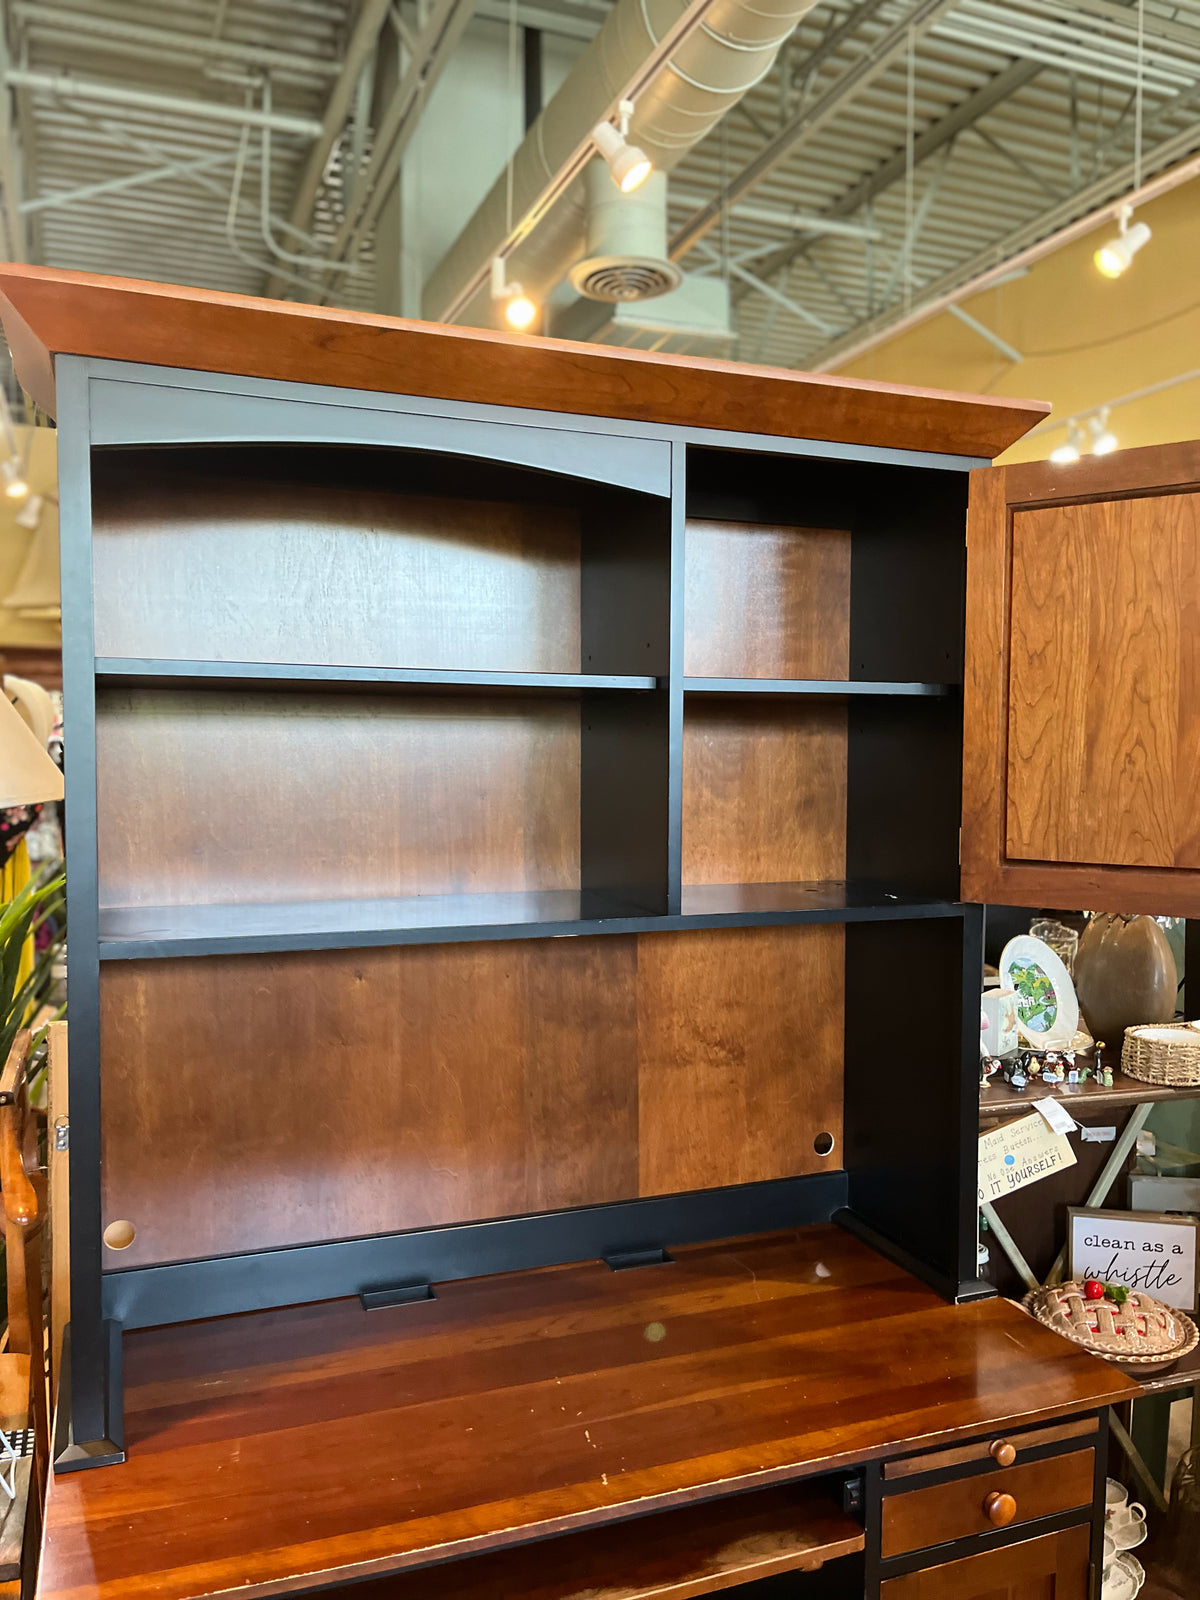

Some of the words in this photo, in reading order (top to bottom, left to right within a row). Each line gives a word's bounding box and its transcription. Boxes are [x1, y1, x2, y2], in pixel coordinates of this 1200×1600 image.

[983, 1133, 1004, 1150] Maid
[1010, 1119, 1044, 1138] Service
[978, 1153, 997, 1167] ress
[987, 1172, 997, 1181] No
[990, 1179, 1001, 1195] IT
[1006, 1152, 1063, 1189] YOURSELF!
[1084, 1235, 1136, 1251] clean
[1142, 1242, 1164, 1253] as
[1171, 1244, 1184, 1255] a
[1083, 1252, 1183, 1289] whistle
